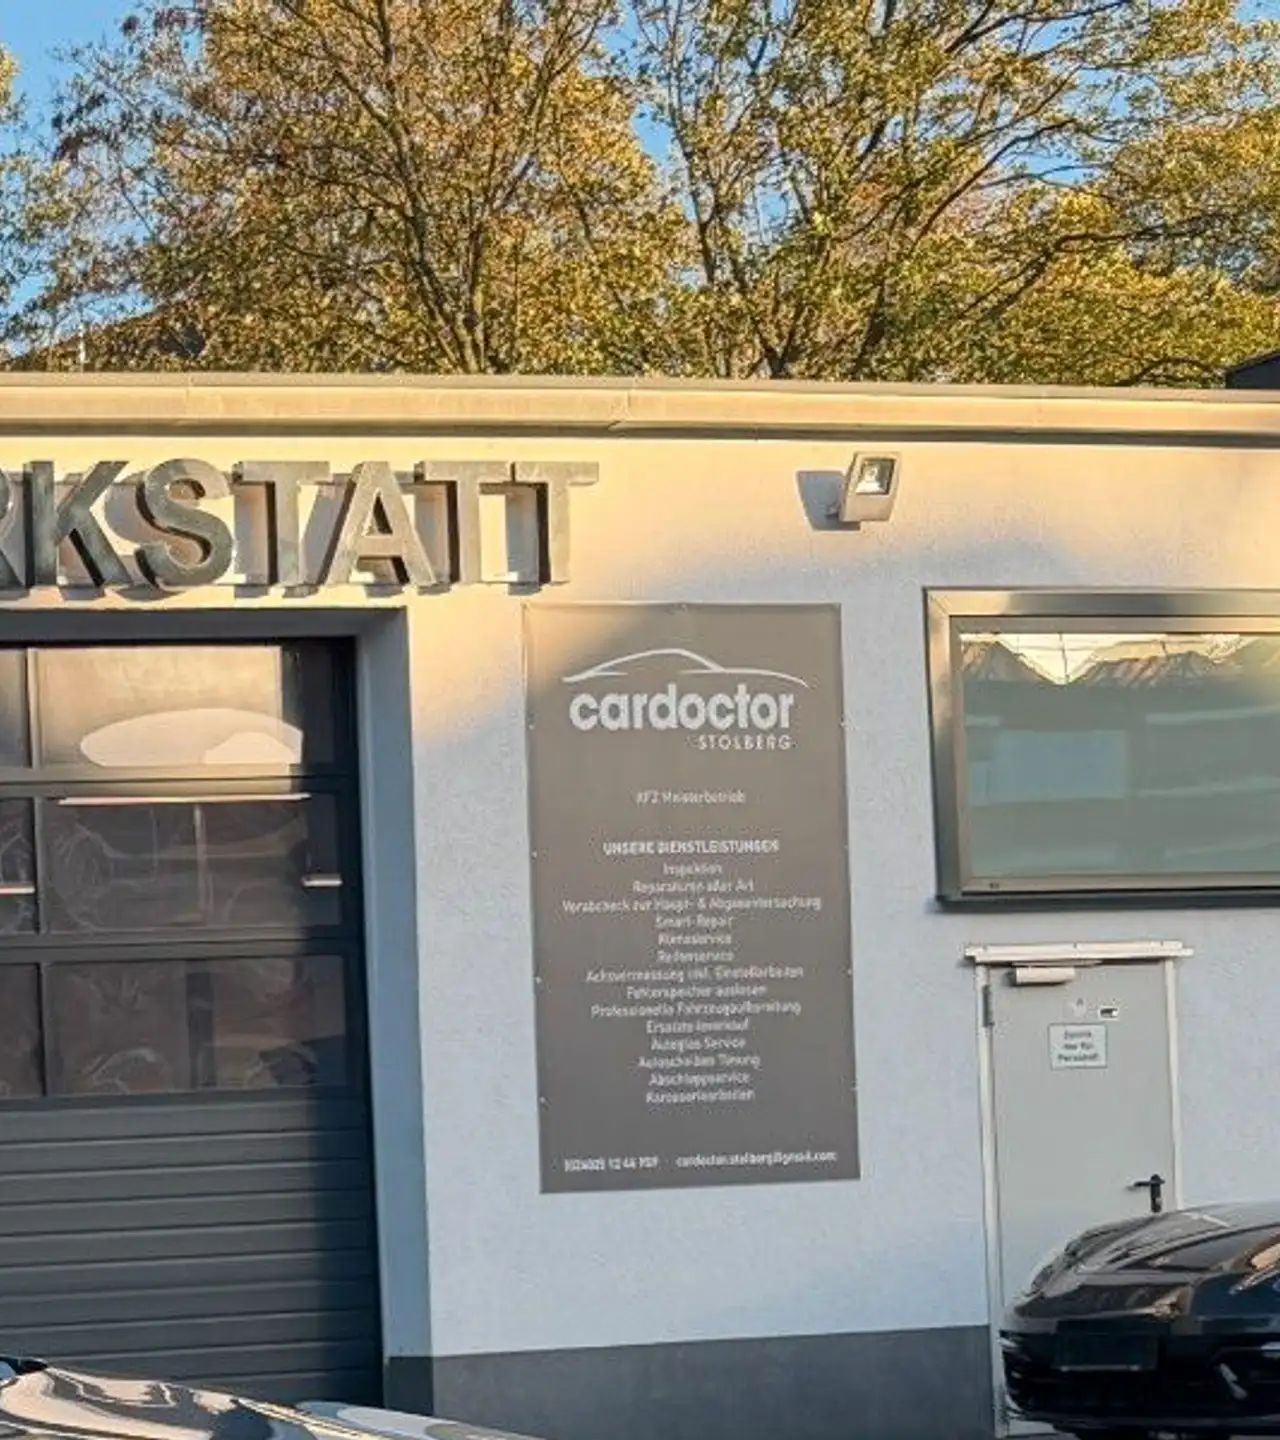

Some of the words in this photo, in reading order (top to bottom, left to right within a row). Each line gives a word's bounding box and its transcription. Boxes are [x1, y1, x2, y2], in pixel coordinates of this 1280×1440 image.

[569, 682, 795, 731] cardoctor
[698, 734, 793, 750] STOLBERG
[602, 840, 656, 856] UNSERE
[657, 838, 780, 855] DIENSTLEISTUNGEN
